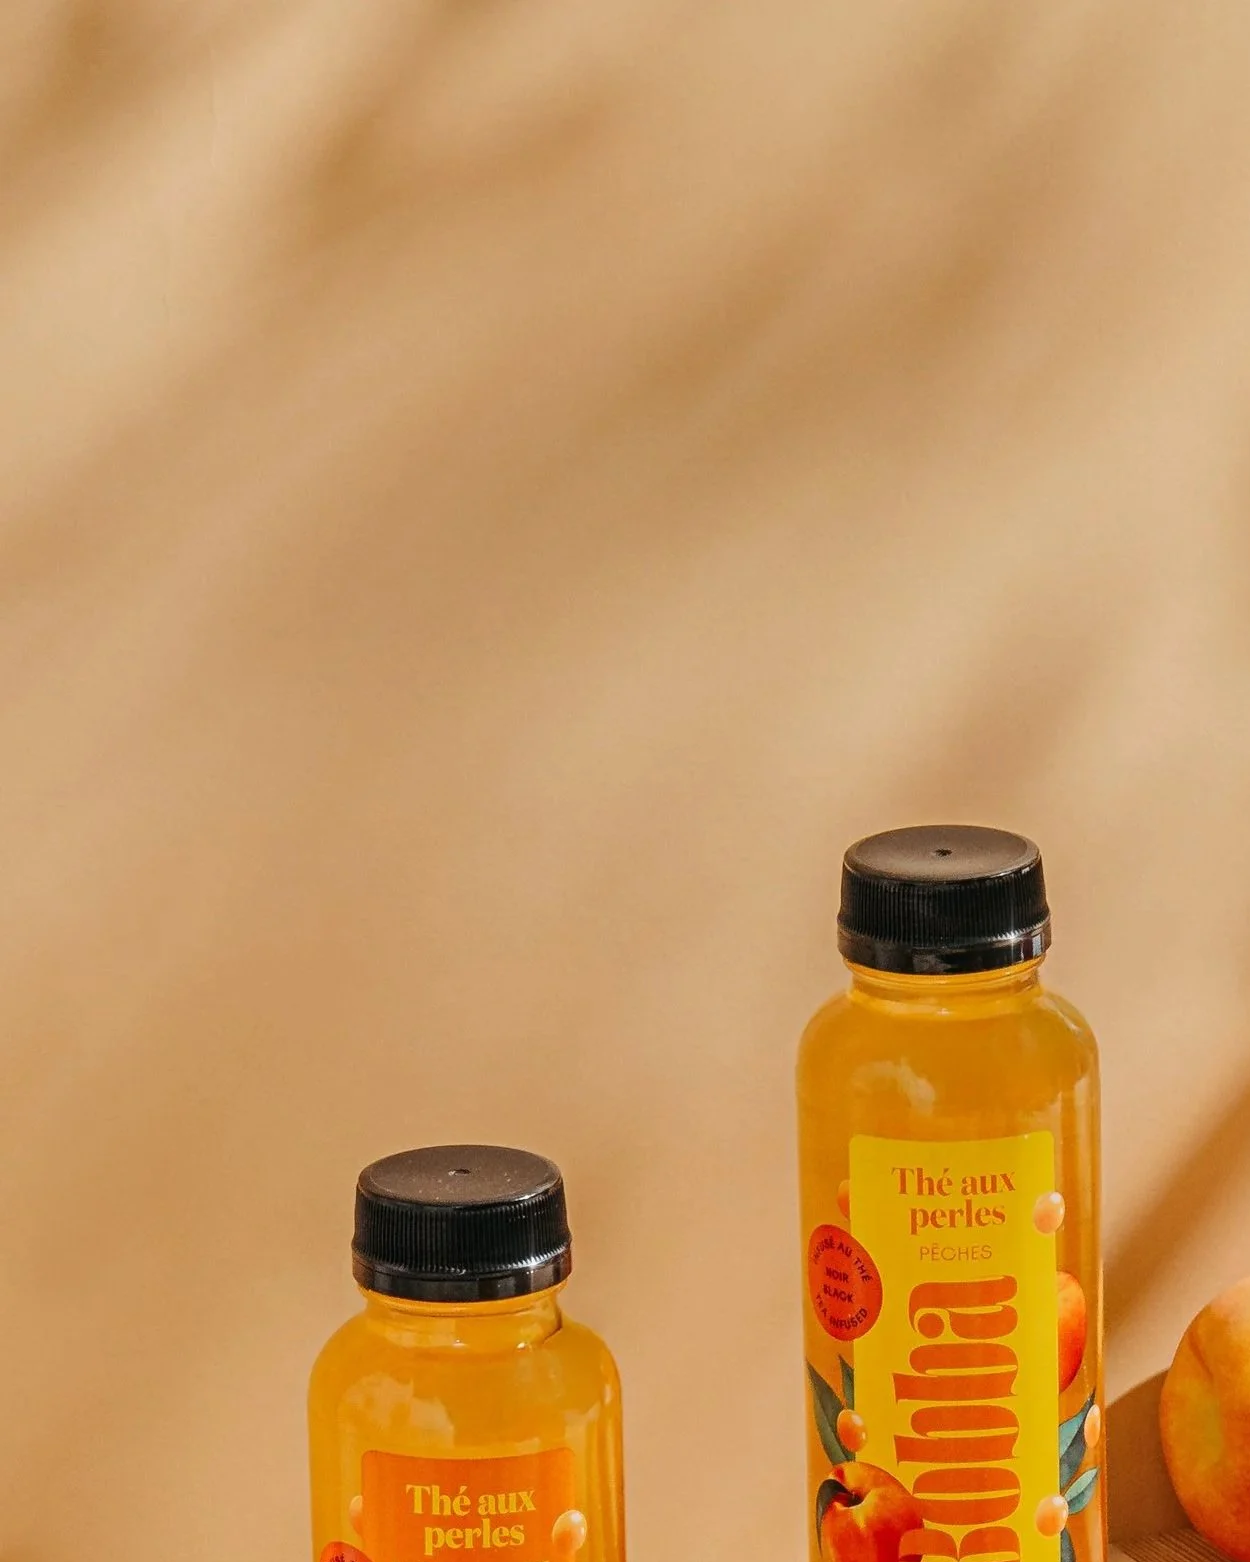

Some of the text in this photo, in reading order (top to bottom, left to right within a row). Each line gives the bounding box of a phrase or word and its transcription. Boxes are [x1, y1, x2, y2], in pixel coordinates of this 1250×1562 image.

[891, 1167, 1016, 1197] Thé aux
[909, 1199, 1006, 1235] perles
[837, 1242, 853, 1257] AU
[919, 1242, 993, 1261] PÊCHES
[825, 1266, 849, 1283] NOIR
[823, 1284, 853, 1304] BLACK
[829, 1308, 868, 1330] INFUSED
[406, 1484, 537, 1516] Thé aux
[424, 1518, 525, 1556] perles
